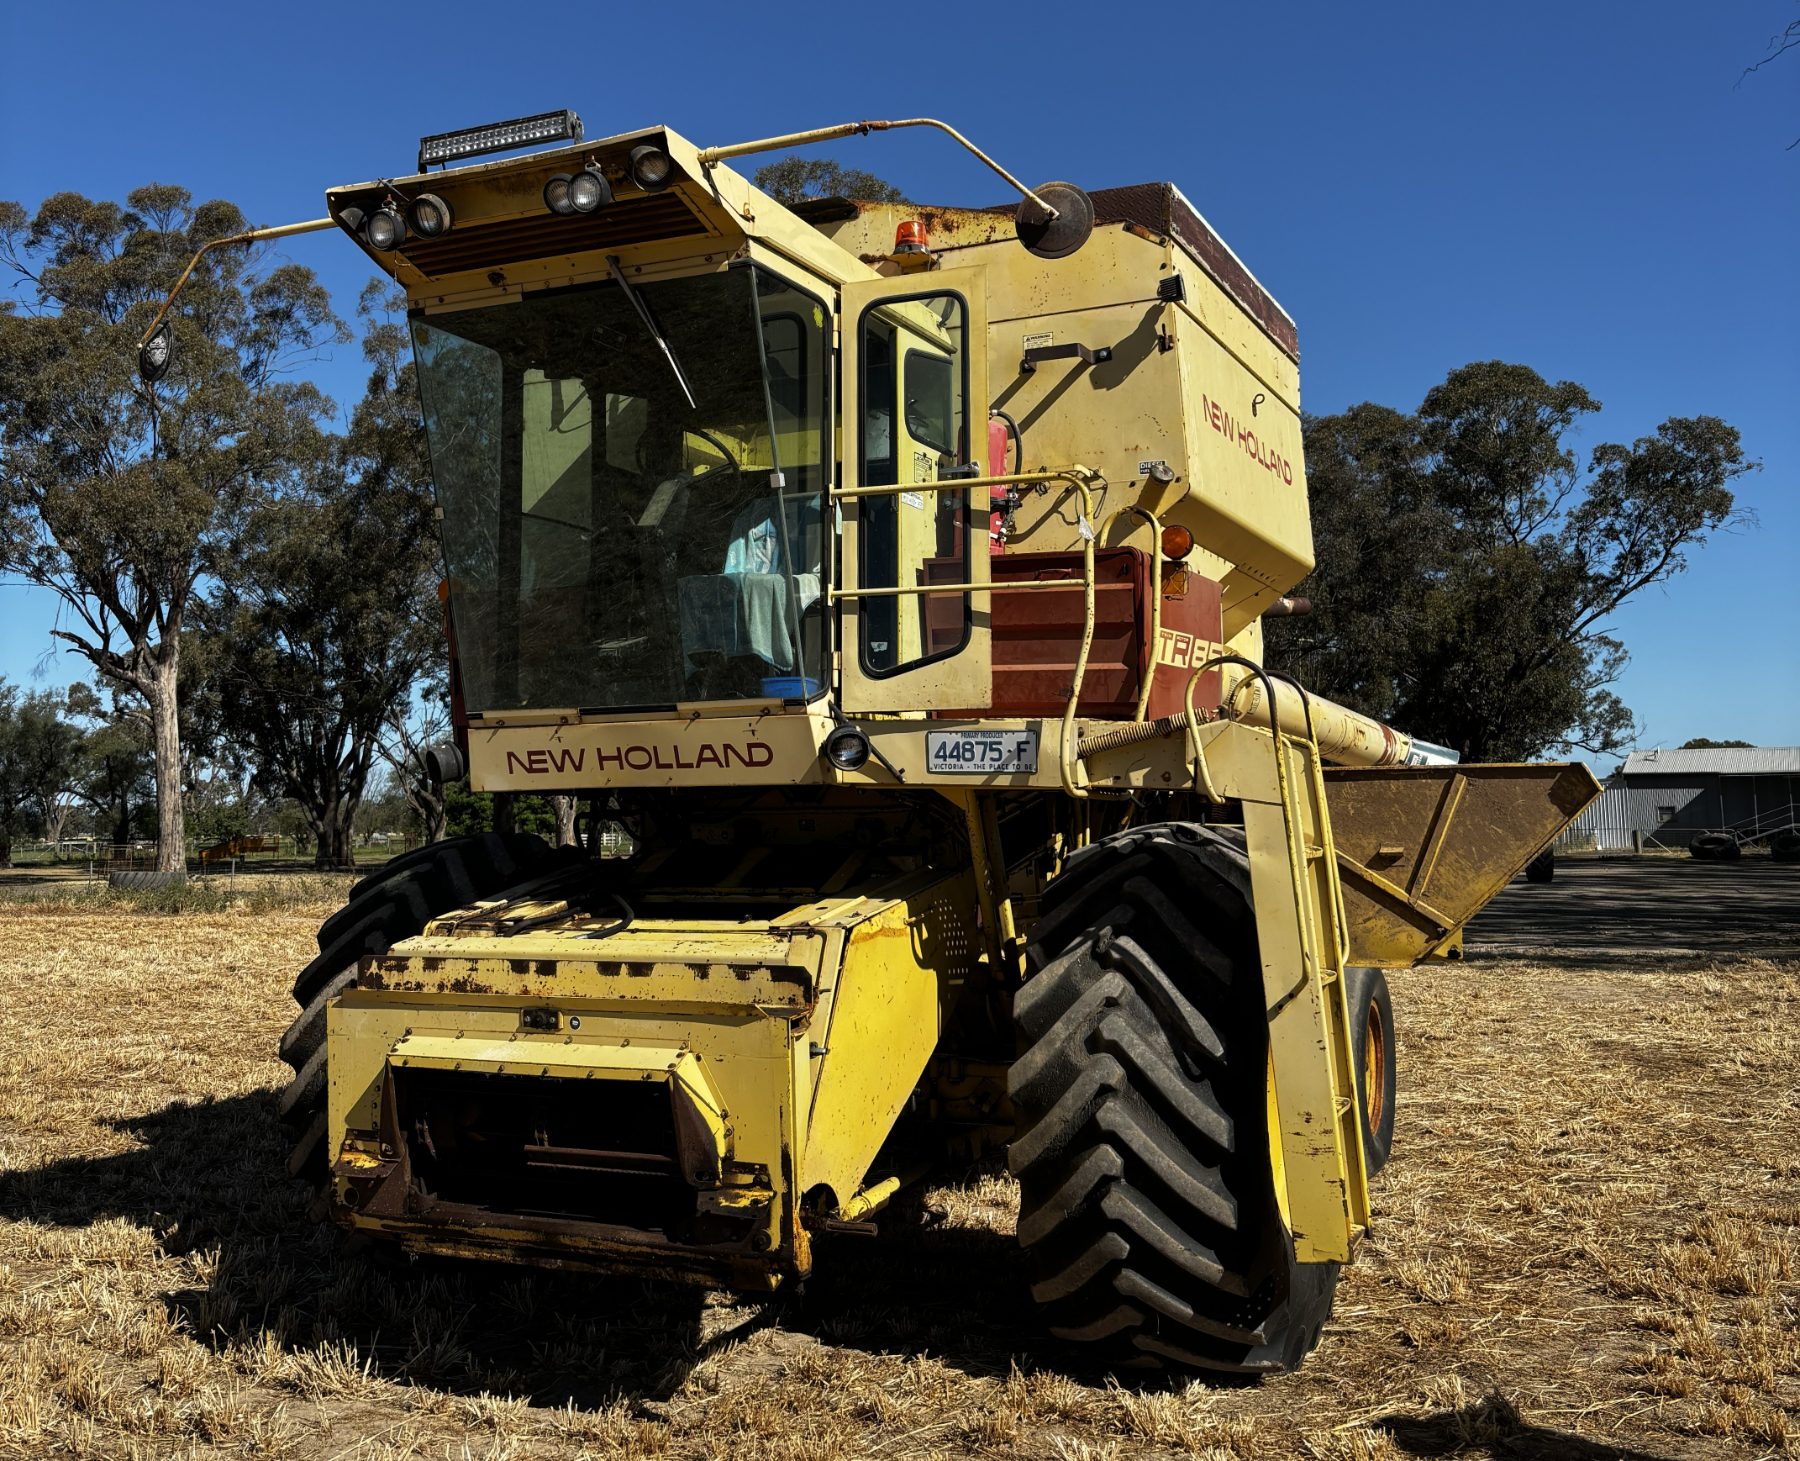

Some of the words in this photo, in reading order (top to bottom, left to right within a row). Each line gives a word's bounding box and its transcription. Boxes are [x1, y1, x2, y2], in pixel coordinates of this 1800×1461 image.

[1202, 393, 1234, 442] NEW
[1237, 421, 1292, 486] HOLLAND
[507, 748, 586, 775] NEW
[596, 742, 774, 771] HOLLAND
